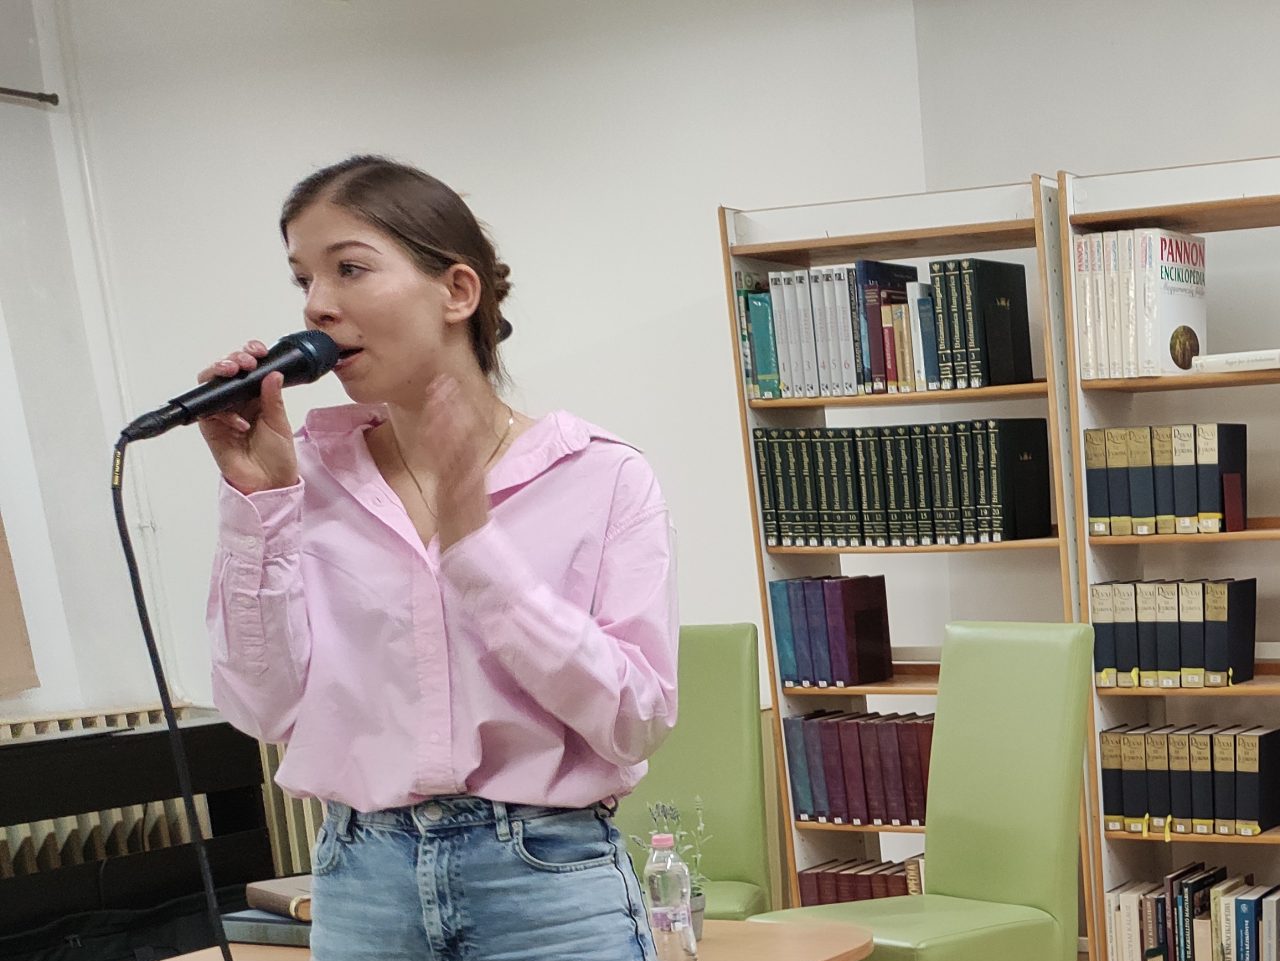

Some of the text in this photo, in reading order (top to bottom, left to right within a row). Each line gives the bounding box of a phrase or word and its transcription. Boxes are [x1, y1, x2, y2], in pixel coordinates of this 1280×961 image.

[1160, 237, 1205, 268] PANNON
[1161, 265, 1206, 287] ENCIKLOPÉDIA
[934, 277, 945, 349] Britannica Hungarica
[949, 276, 961, 349] Britannica Hungarica
[964, 274, 975, 347] Britannica Hungarica
[757, 442, 770, 509] Britannica Hungarica
[773, 442, 786, 510] Britannica Hungarica
[786, 442, 799, 510] Britannica Hungarica
[801, 442, 813, 510] Britannica Hungarica
[816, 442, 828, 510] Britannica Hungarica
[829, 442, 841, 510] Britannica Hungarica
[843, 442, 854, 510] Britannica Hungarica
[857, 441, 868, 510] Britannica Hungarica
[869, 441, 881, 510] Britannica Hungarica
[885, 440, 896, 509] Britannica Hungarica
[899, 440, 911, 508] Britannica Hungarica
[915, 438, 926, 508] Britannica Hungarica
[931, 438, 942, 507] Britannica Hungarica
[943, 437, 954, 507] Britannica Hungarica
[960, 436, 968, 470] Hungarica
[976, 434, 985, 468] Hungarica
[989, 433, 997, 468] Hungarica
